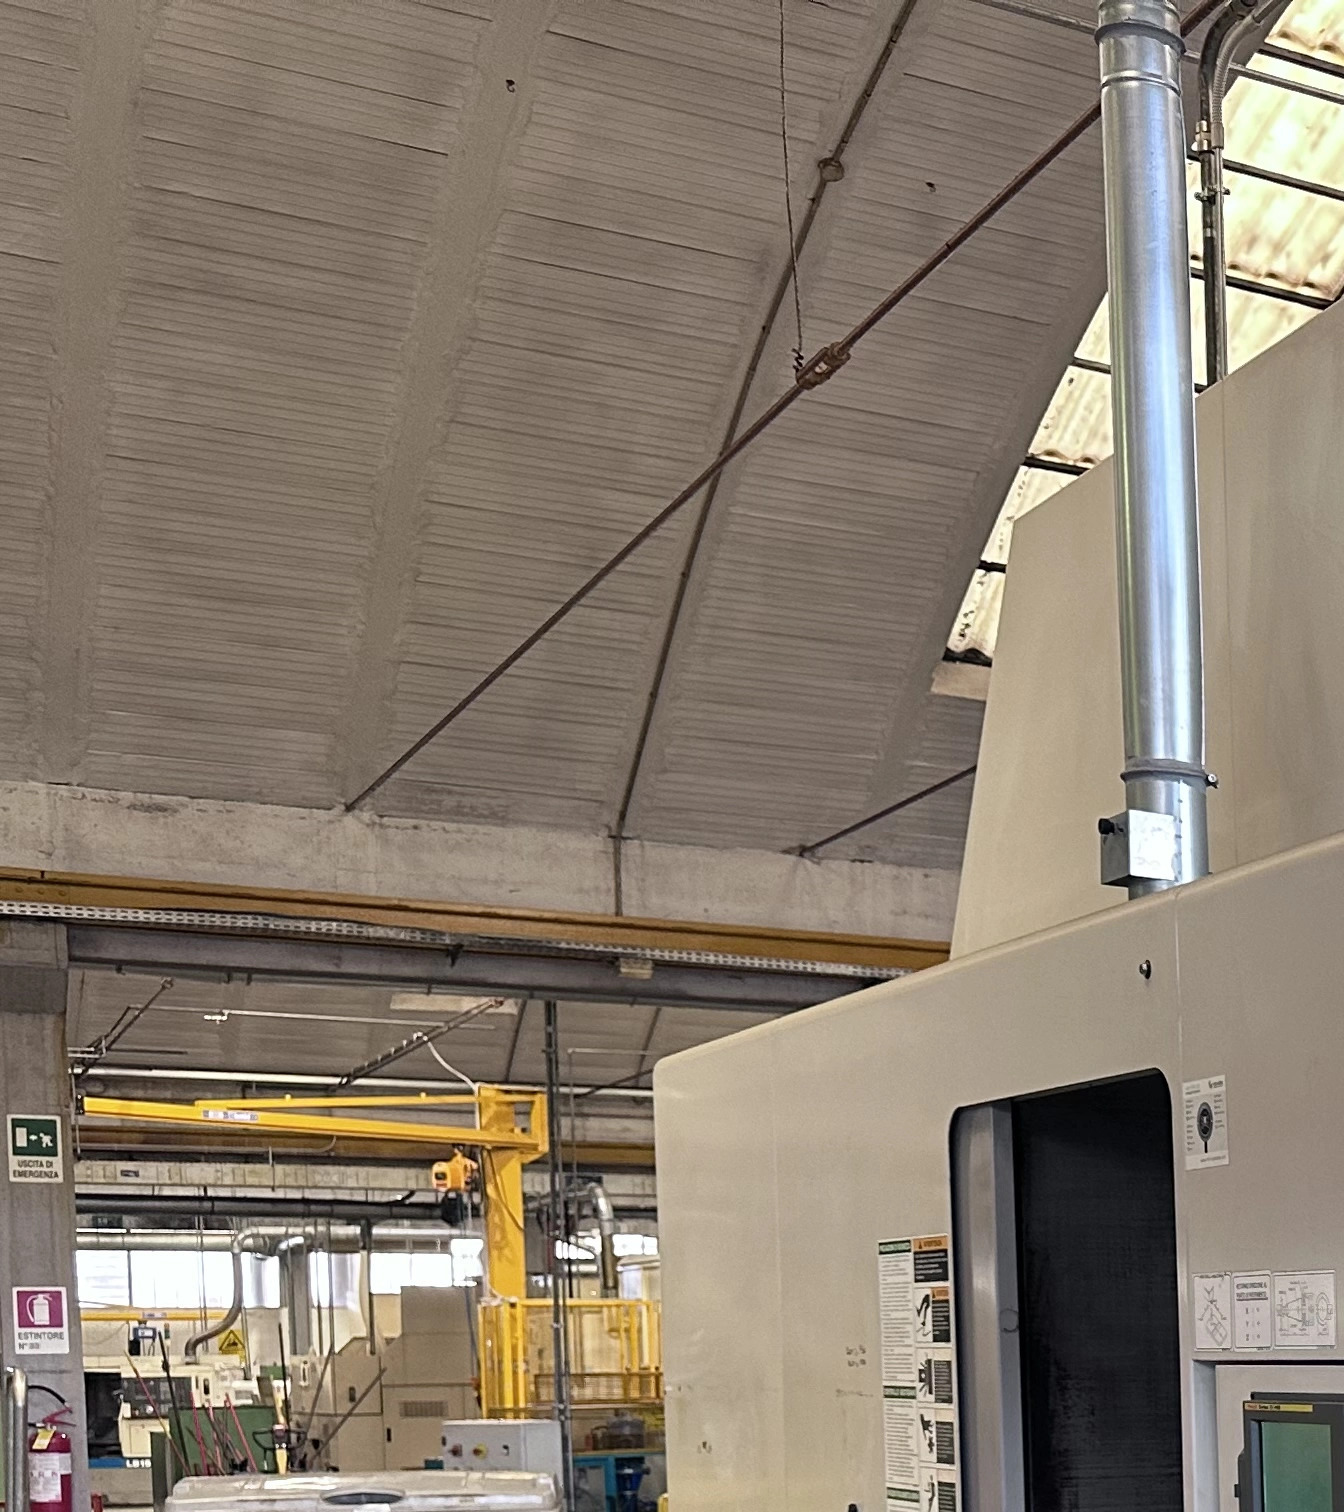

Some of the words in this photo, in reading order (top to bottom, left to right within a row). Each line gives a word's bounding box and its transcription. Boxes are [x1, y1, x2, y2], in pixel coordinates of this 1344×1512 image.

[17, 1159, 44, 1168] USCITA
[46, 1160, 54, 1168] DI
[13, 1169, 59, 1178] EMERGENZA
[18, 1331, 64, 1340] ESTINTORE
